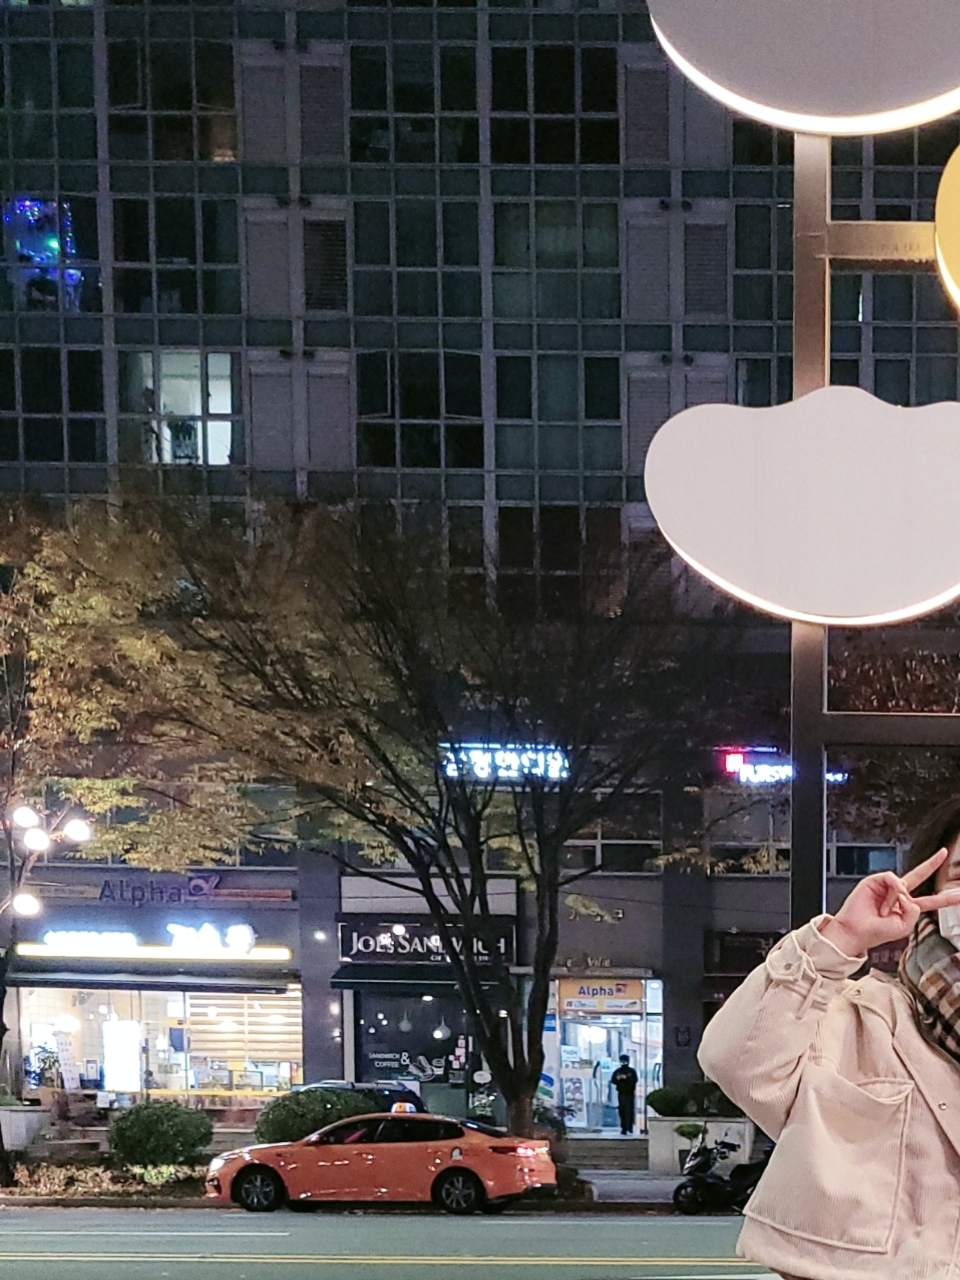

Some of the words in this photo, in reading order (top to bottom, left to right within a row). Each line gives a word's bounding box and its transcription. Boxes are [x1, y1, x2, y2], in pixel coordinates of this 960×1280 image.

[98, 879, 185, 907] Alpha
[578, 985, 614, 997] Alpha
[400, 1051, 410, 1065] &
